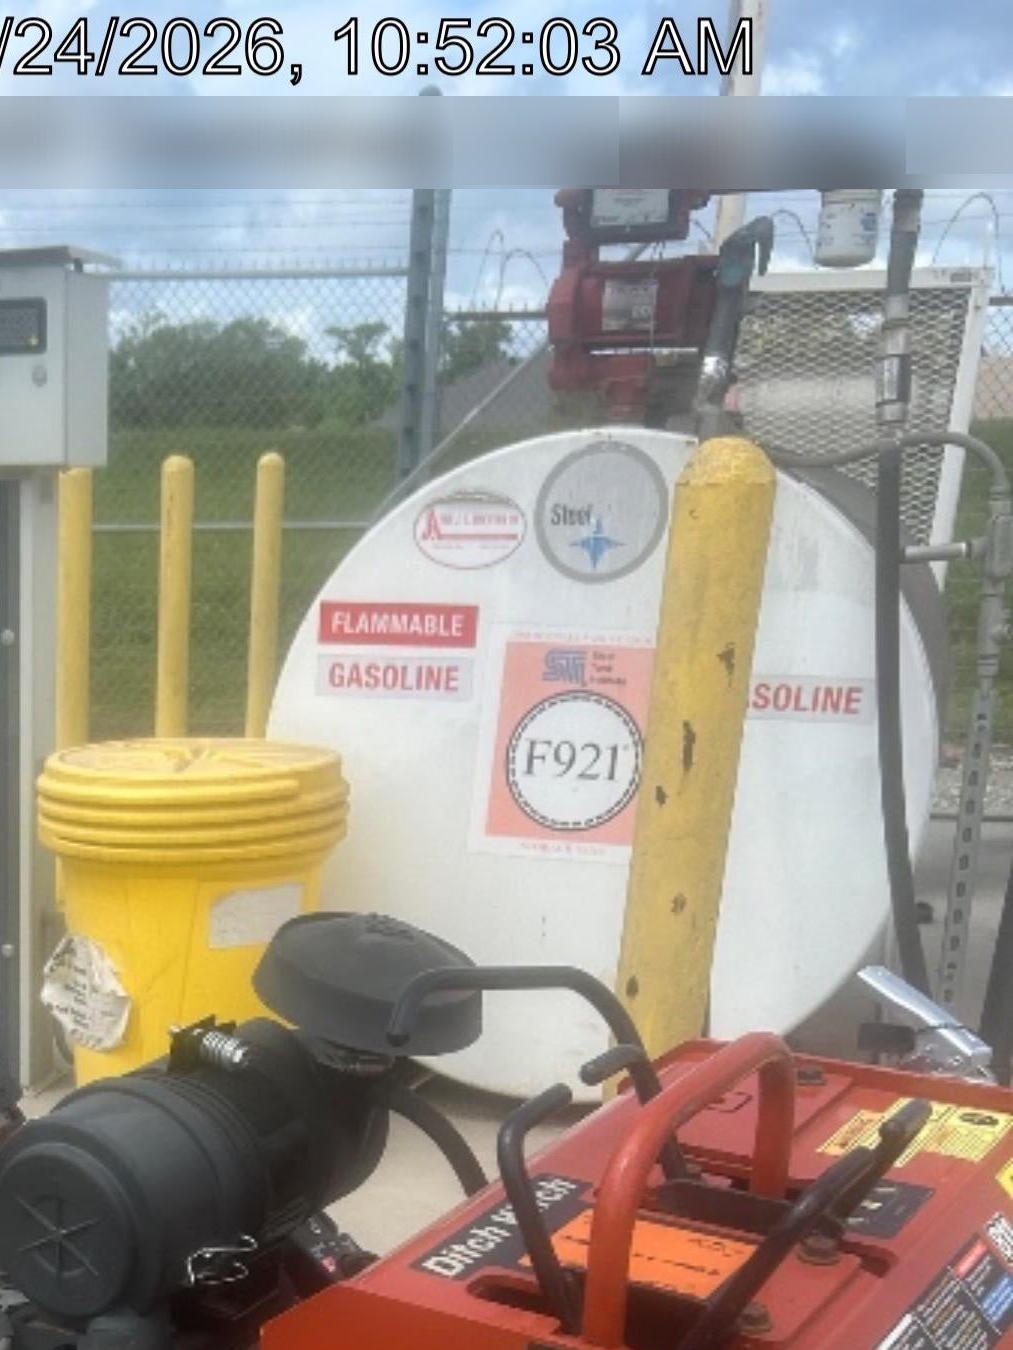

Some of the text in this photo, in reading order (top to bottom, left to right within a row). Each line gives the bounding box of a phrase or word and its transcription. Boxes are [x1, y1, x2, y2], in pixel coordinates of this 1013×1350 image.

[331, 610, 466, 637] FLAMMABLE
[329, 661, 460, 692] GASOLINE
[747, 682, 863, 715] SOLINE
[421, 1226, 512, 1278] Ditch
